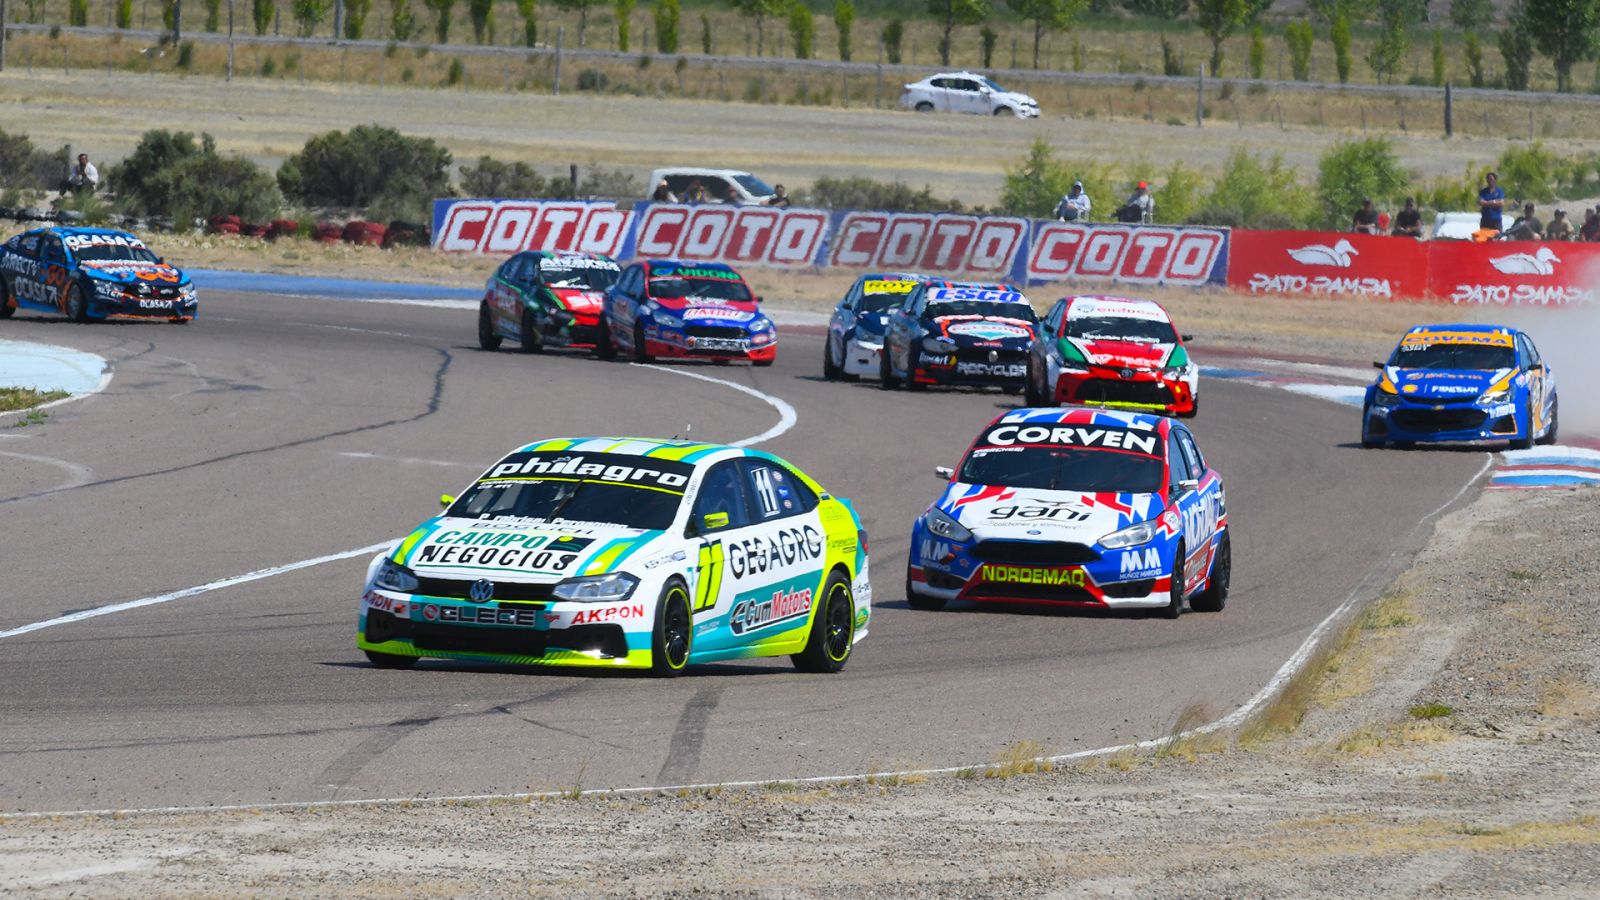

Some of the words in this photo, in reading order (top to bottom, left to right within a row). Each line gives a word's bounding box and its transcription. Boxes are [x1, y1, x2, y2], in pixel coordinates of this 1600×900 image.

[444, 207, 626, 254] COTO
[638, 211, 820, 260] COTO
[841, 215, 1018, 268] COTO
[1036, 230, 1216, 279] COTO
[1249, 273, 1307, 292] PATO
[1310, 277, 1392, 298] PAMPA
[1452, 284, 1509, 304] PATO
[1512, 285, 1596, 305] PAMPA
[987, 425, 1157, 455] CORVEN
[489, 456, 688, 486] philagro
[434, 530, 550, 550] CAMPO
[418, 545, 579, 571] NEGOCIOS
[1121, 548, 1161, 573] MM
[981, 565, 1086, 588] NORDEMAQ
